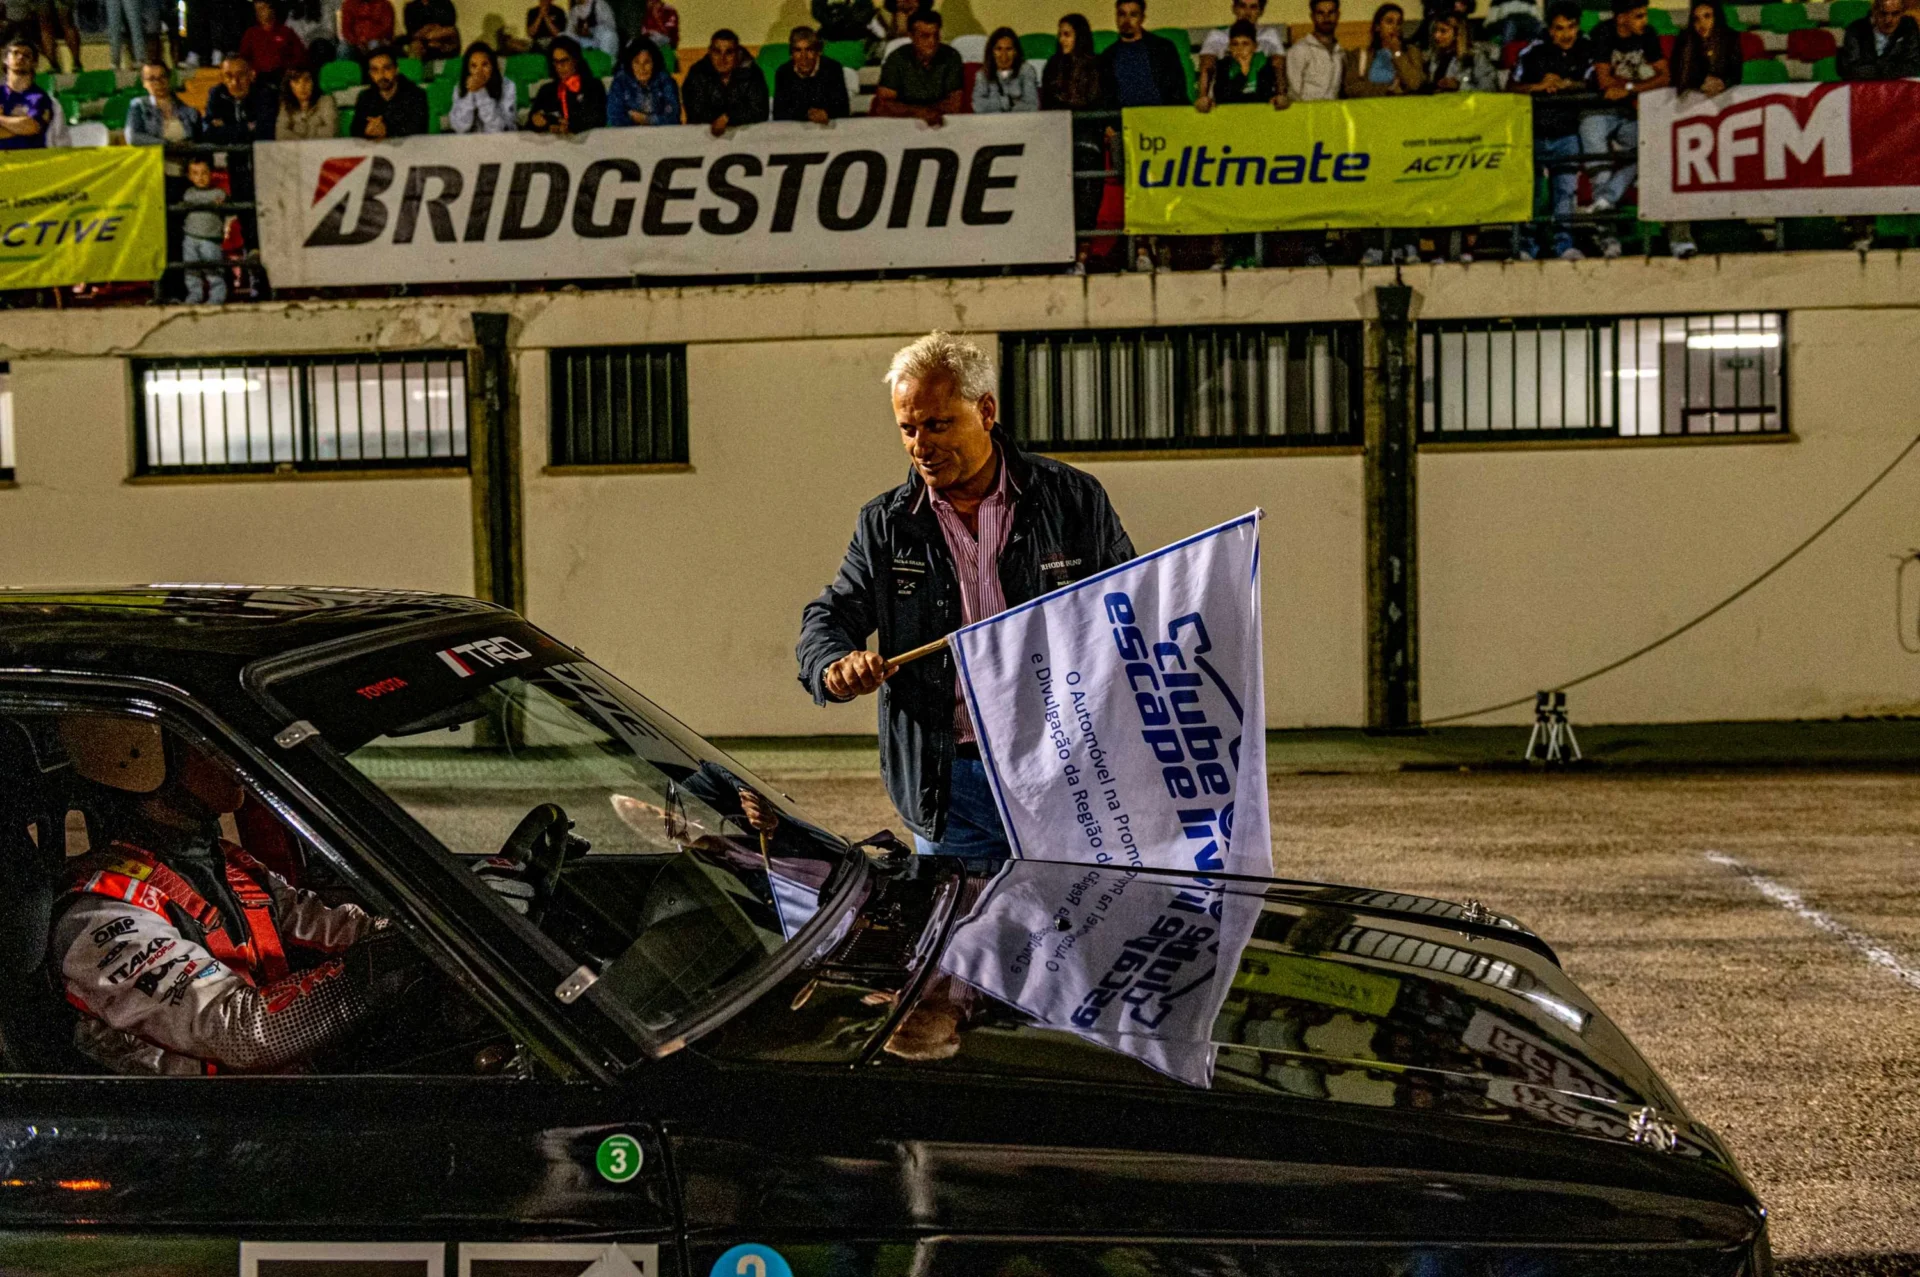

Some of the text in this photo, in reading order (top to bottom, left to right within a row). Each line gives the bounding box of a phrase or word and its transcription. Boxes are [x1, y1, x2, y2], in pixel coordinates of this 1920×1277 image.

[1138, 132, 1166, 155] bp
[1676, 84, 1853, 186] RFM
[1138, 142, 1370, 188] ultimate
[1403, 152, 1505, 174] ACTIVE
[303, 142, 1025, 248] BRIDGESTONE
[0, 216, 124, 248] CTIVE
[1031, 653, 1043, 664] e
[356, 676, 408, 700] TOYOTA
[1066, 671, 1081, 686] O
[1103, 591, 1198, 800] escape
[1036, 667, 1071, 760] Divulgação
[1153, 641, 1231, 796] clube
[1070, 691, 1116, 786] Automóvel
[1063, 764, 1081, 786] da
[1104, 788, 1121, 811] na
[1072, 789, 1103, 848] Região
[94, 917, 136, 945] OMP
[107, 937, 171, 985] ITAKA
[609, 1148, 627, 1174] 3
